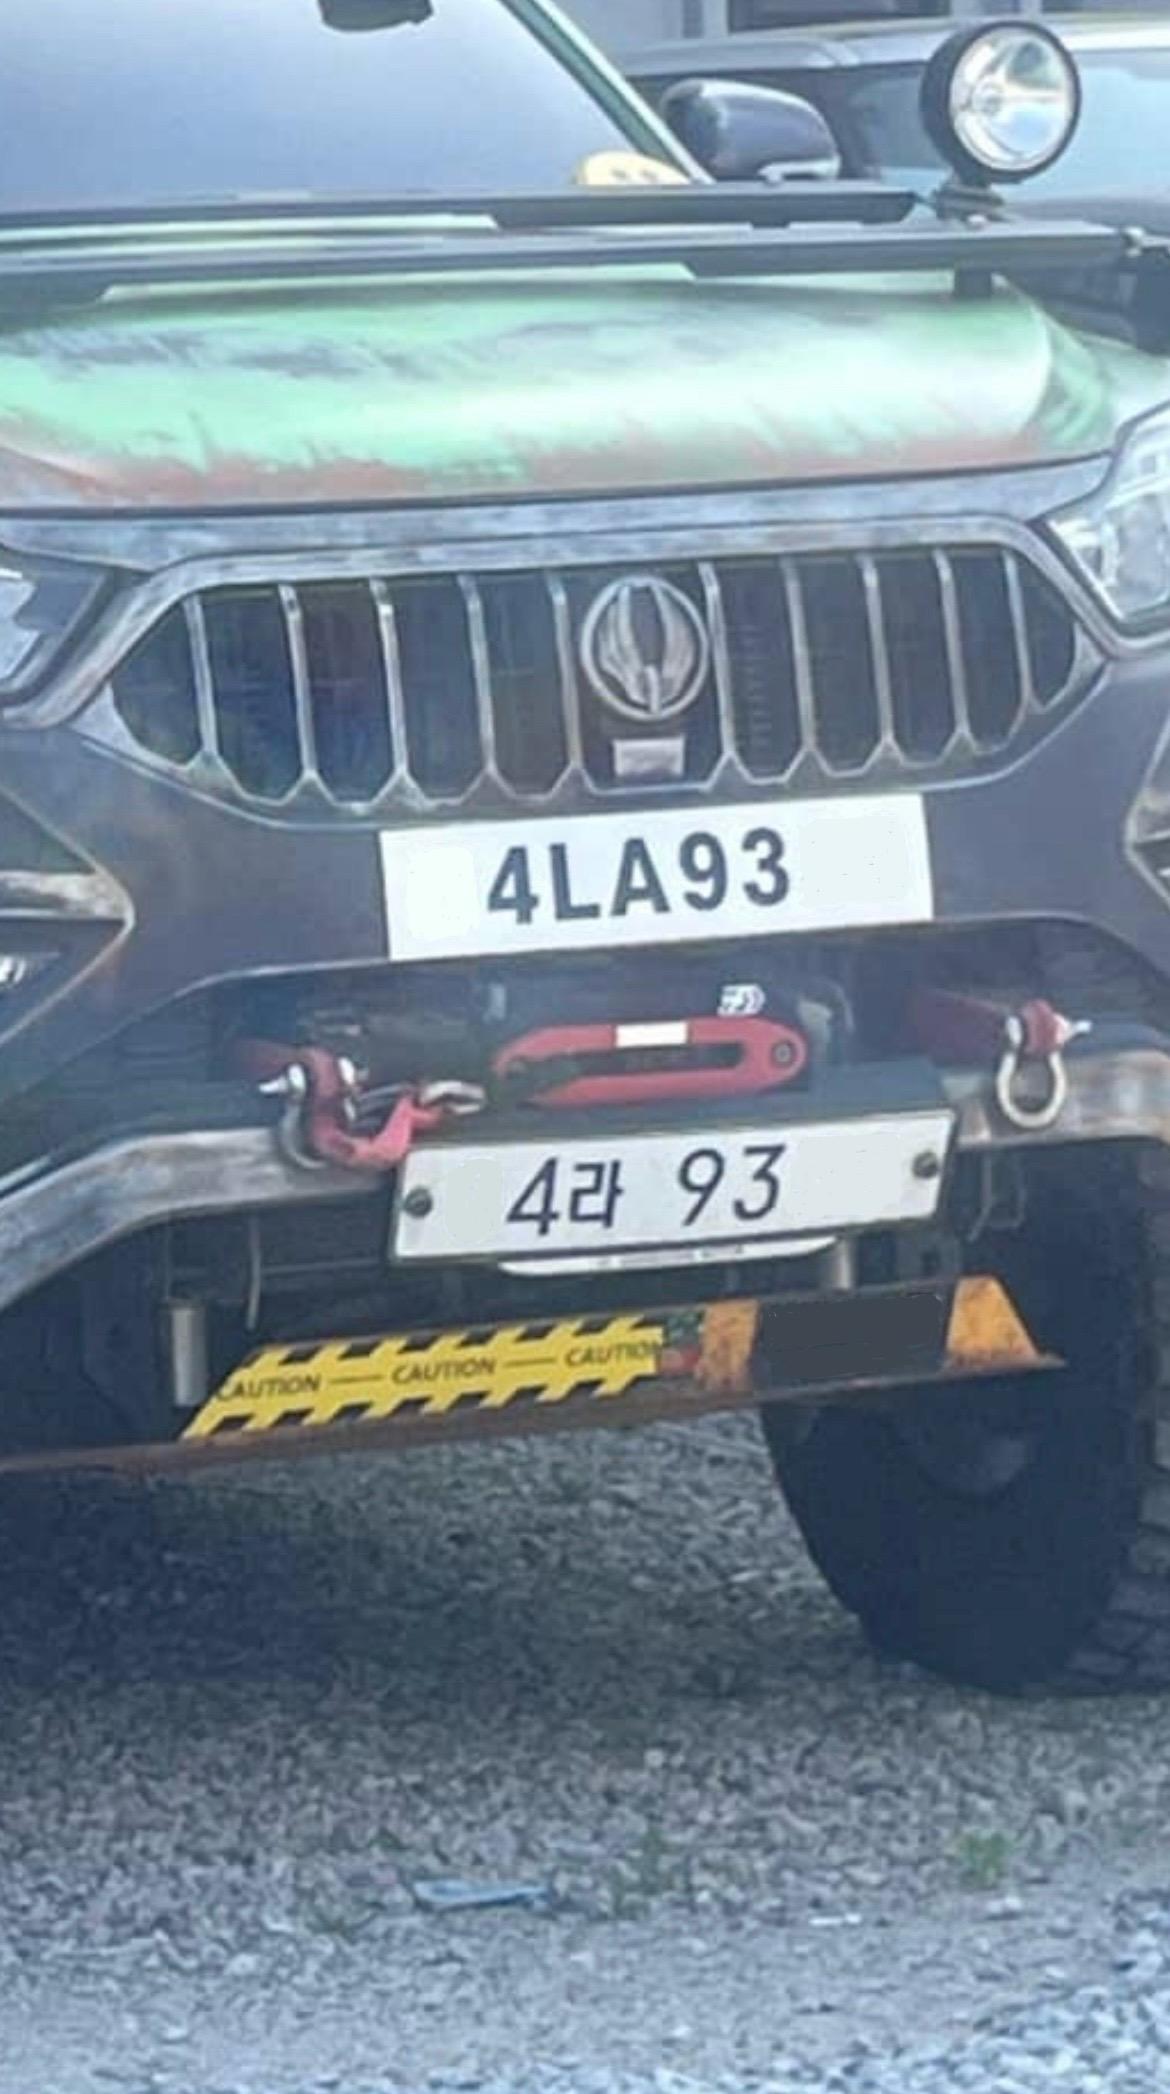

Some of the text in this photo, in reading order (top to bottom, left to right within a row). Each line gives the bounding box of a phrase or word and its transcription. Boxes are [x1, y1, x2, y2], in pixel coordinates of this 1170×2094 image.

[487, 827, 790, 924] 4LA93
[506, 1143, 786, 1236] 4라 93
[391, 1357, 496, 1385] CAUTION
